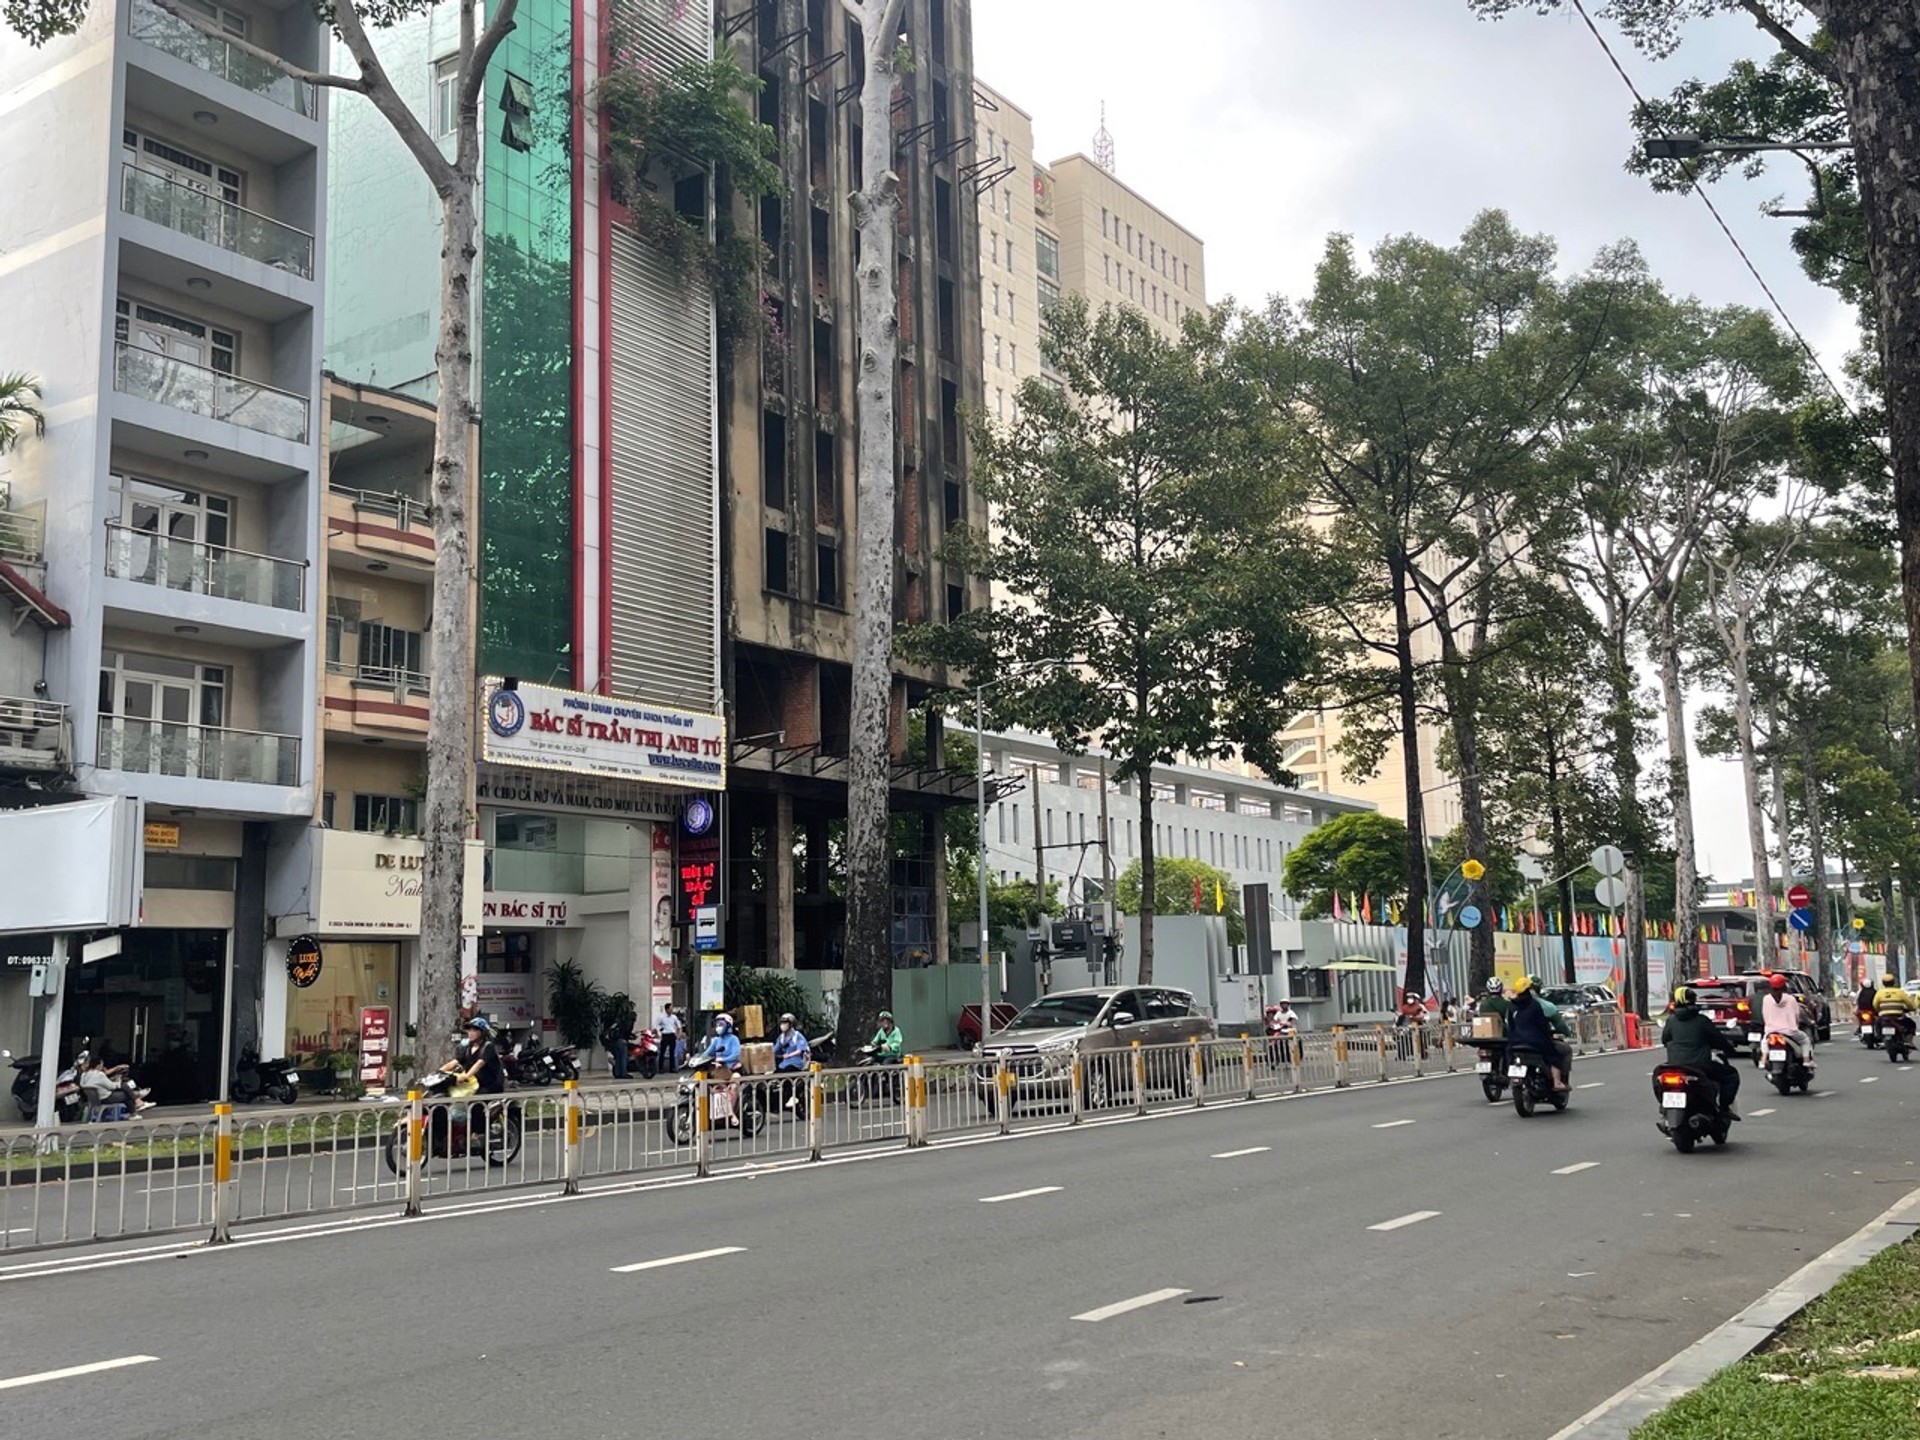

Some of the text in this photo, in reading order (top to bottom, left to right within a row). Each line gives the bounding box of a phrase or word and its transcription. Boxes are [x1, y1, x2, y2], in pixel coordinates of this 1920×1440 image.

[530, 708, 721, 757] BÁC SĨ TRẦN THỊ ANH TÚ
[494, 787, 516, 800] CHO
[375, 853, 396, 870] DE
[385, 875, 423, 897] Nail
[685, 878, 713, 893] BÁC
[500, 899, 528, 918] BÁC
[531, 901, 545, 918] SĨ
[548, 900, 567, 919] TÚ
[688, 909, 696, 920] T
